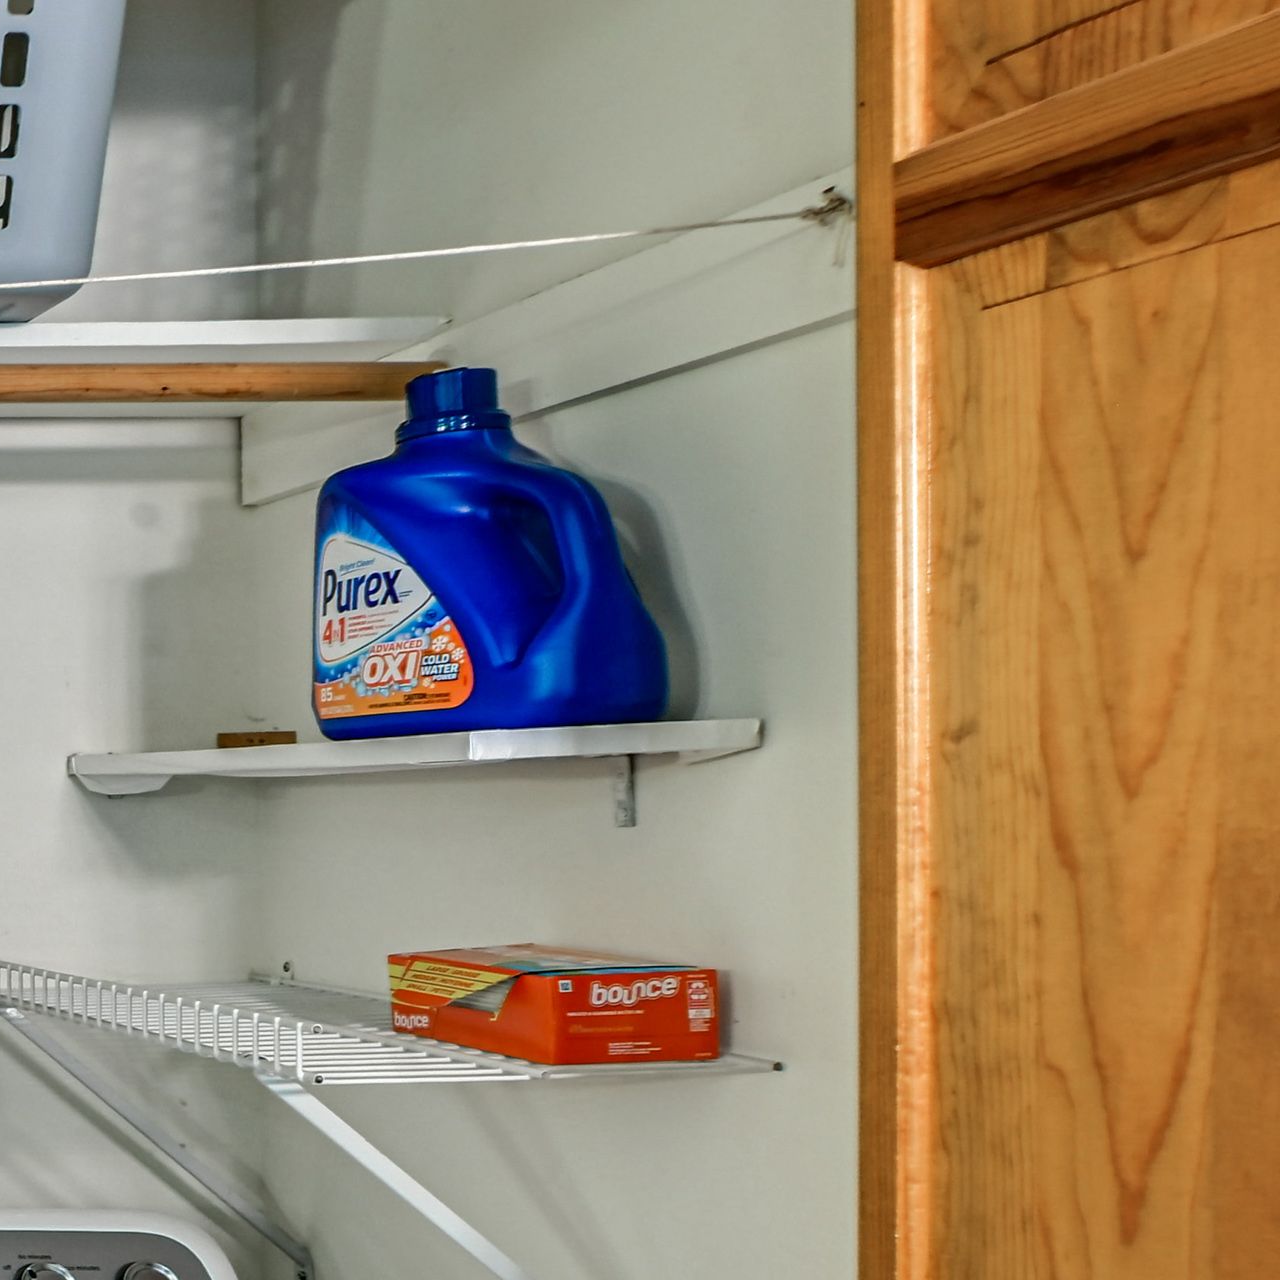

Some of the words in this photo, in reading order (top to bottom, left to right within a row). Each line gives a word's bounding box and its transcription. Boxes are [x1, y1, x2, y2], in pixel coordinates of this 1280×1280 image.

[322, 569, 402, 616] Purex
[370, 639, 423, 653] ADVANCED
[364, 651, 418, 684] OXI
[422, 654, 450, 665] COLD
[420, 664, 459, 675] WATER
[591, 976, 679, 1006] bounce
[393, 1011, 429, 1029] bounce
